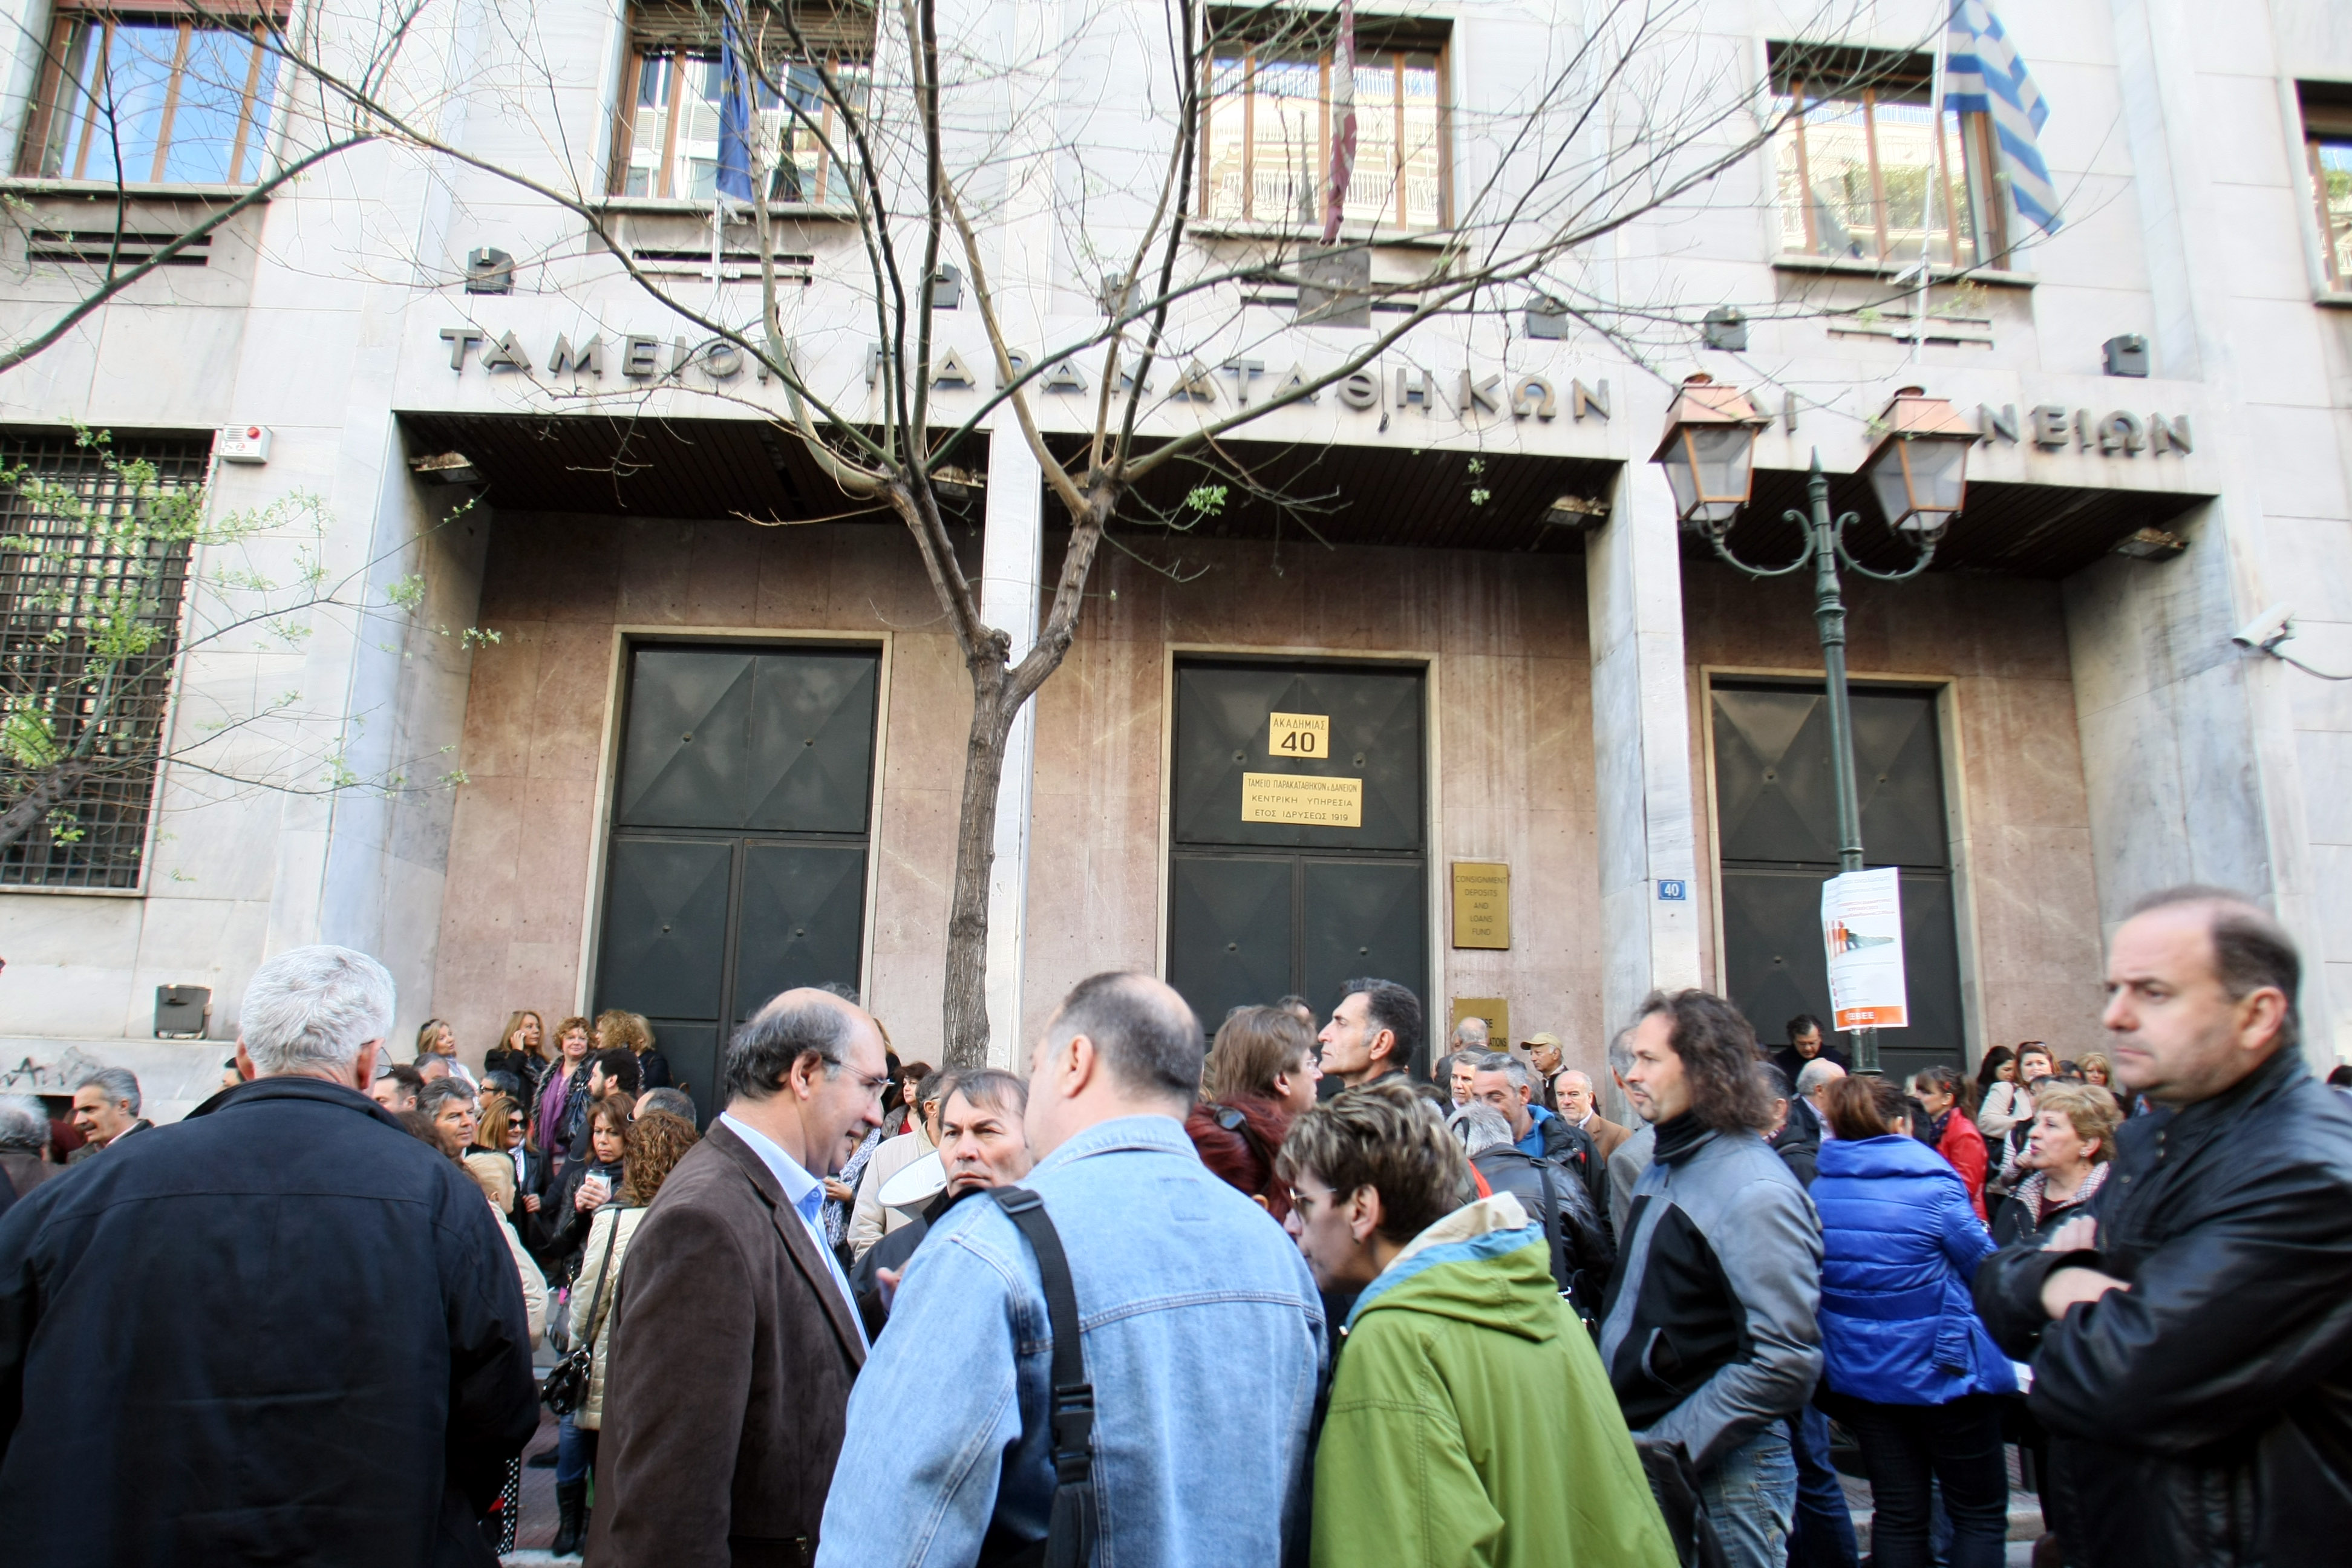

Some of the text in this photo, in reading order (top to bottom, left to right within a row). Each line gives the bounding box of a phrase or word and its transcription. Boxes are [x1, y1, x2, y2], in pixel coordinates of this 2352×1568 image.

[1977, 402, 2194, 455] ΝΕΙΩΝ
[1273, 717, 1325, 730] ΑΚΑΔΗΜΙΑΣ
[1281, 731, 1315, 753] 40
[1248, 778, 1270, 788] ΤΑΜΕΙΟ
[1273, 779, 1327, 791] ΠΑΡΑΚΑΤΑΘΗΚΩΝ
[1331, 783, 1357, 793] ΔΑΝΕΙΩΝ
[1252, 794, 1353, 807] ΚΕΝΤΡΙΚΗ ΥΠΗΡΕΣΙΑ
[1255, 809, 1348, 822] ΕΤΟΣ ΙΔΡΥΣΕΩΣ 1919
[1455, 875, 1506, 884] CONSIGNMENT
[1465, 888, 1498, 897] DEPOSITS
[1664, 883, 1679, 897] 40
[1470, 915, 1493, 923] LOANS
